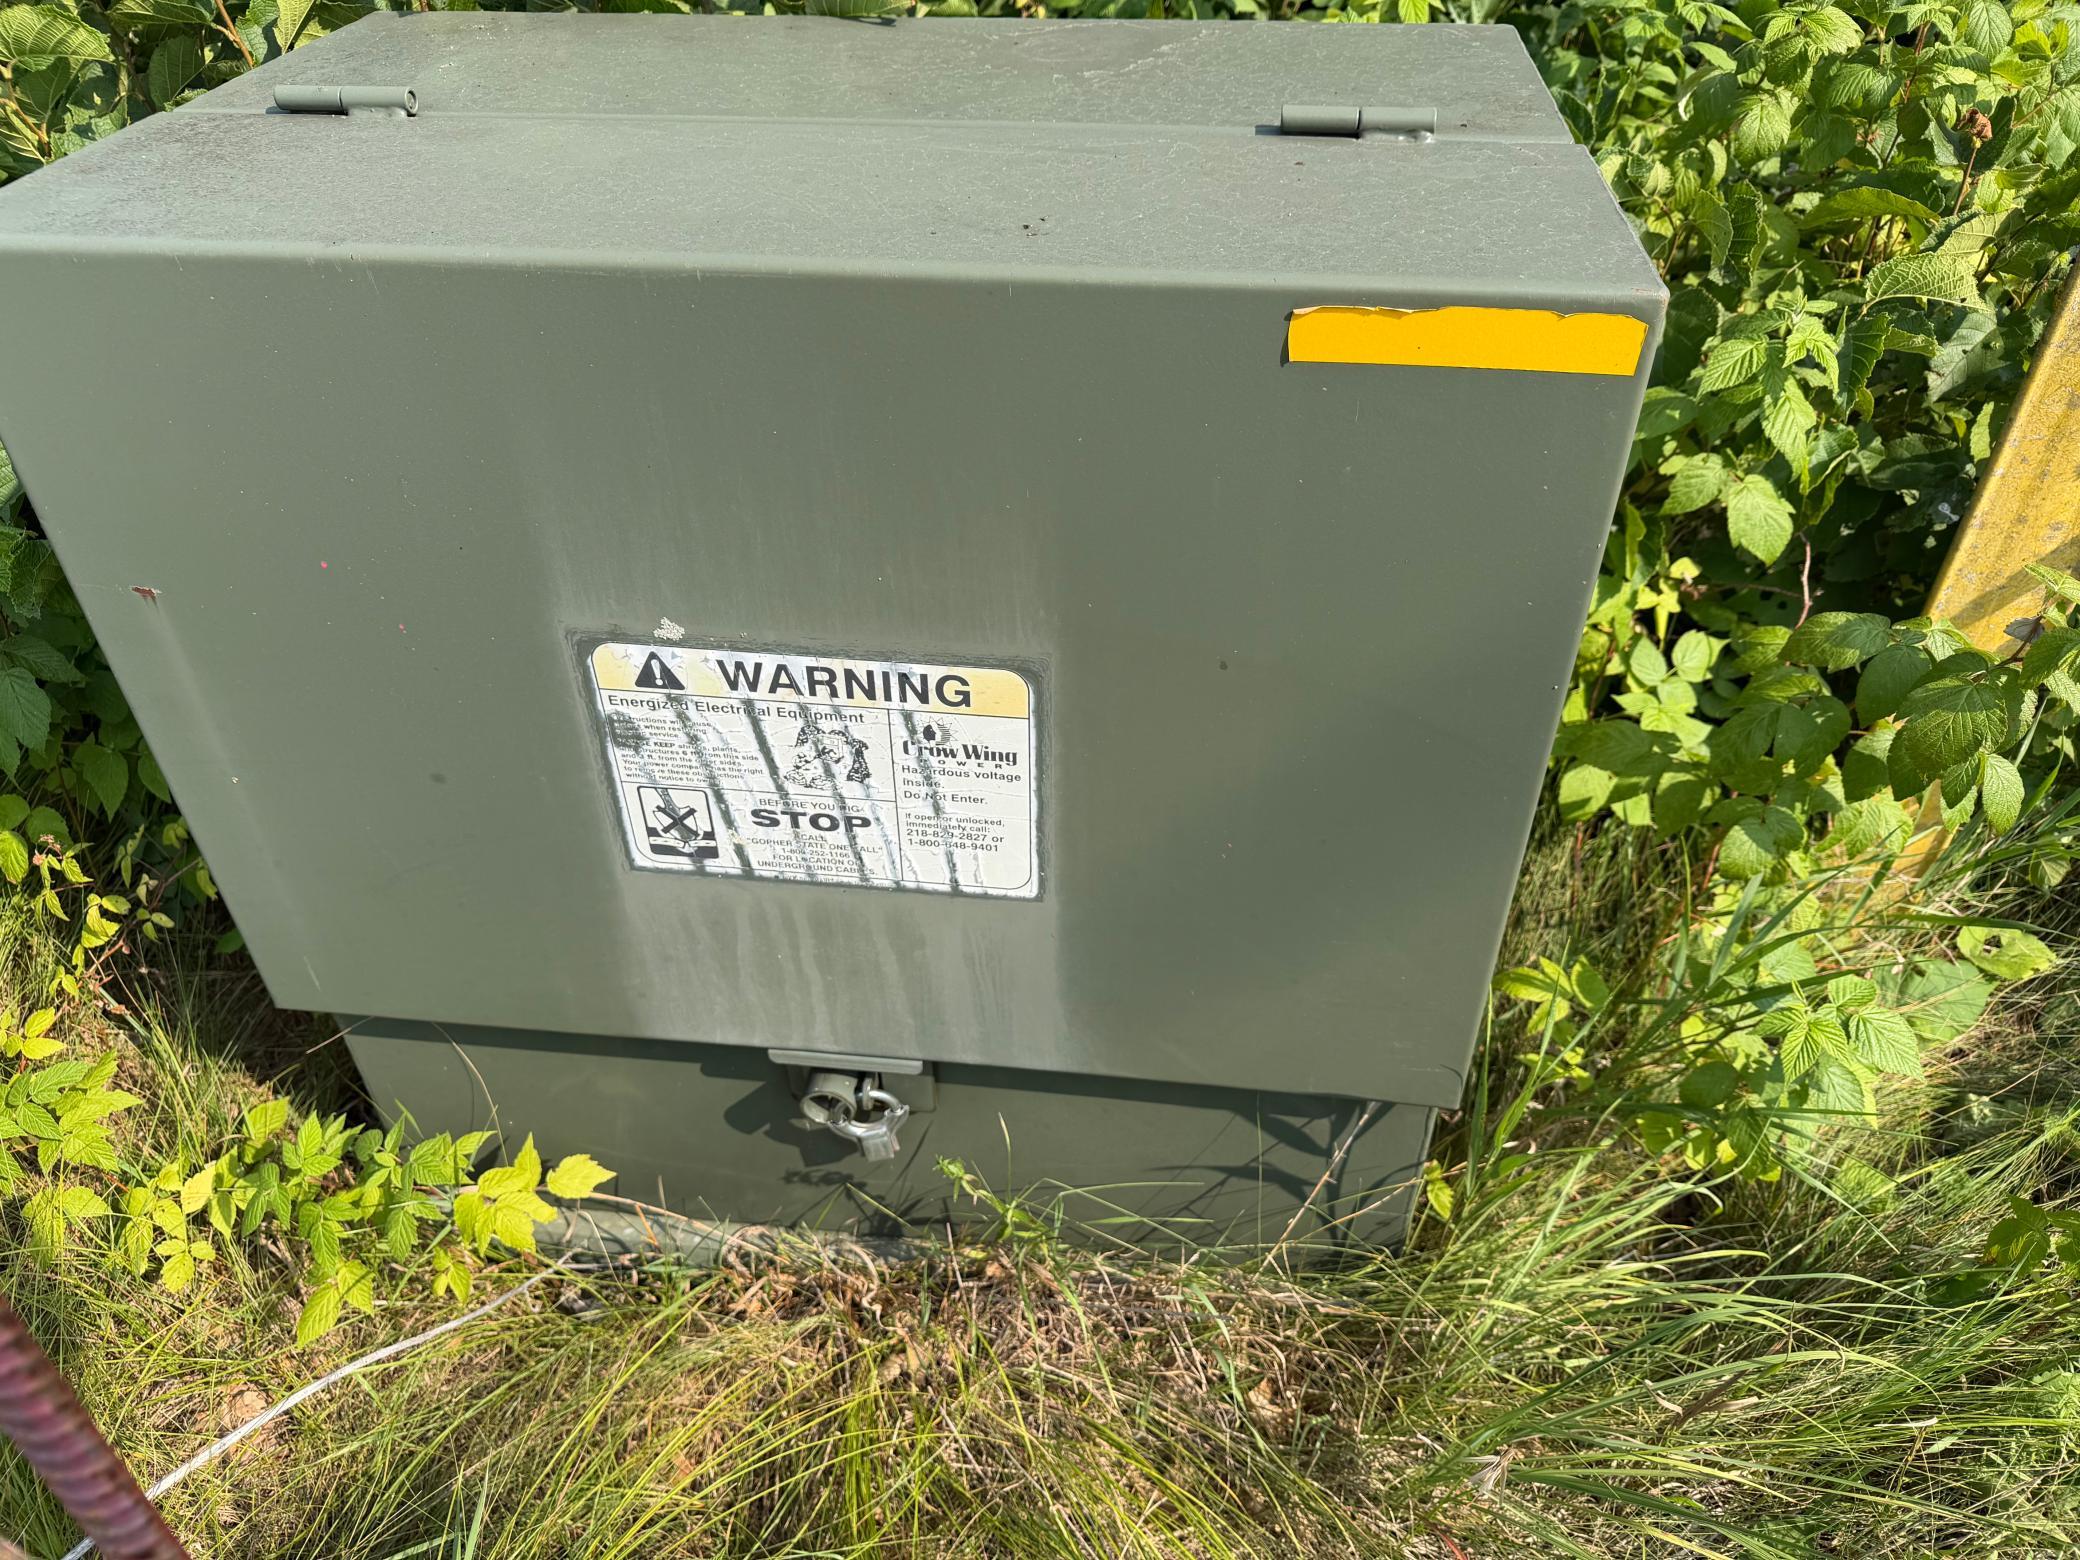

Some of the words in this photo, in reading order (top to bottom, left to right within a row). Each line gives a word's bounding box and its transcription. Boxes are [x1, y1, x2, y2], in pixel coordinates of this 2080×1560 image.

[716, 659, 971, 708] WARNING
[608, 695, 689, 711] Energized
[695, 701, 770, 717] Electrical
[777, 708, 865, 724] Equipment
[612, 713, 668, 724] tructions
[644, 723, 666, 731] when
[640, 748, 680, 756] ructures
[902, 740, 959, 759] Crow
[962, 744, 1018, 767] Wing
[644, 761, 669, 769] power
[744, 768, 764, 776] right
[695, 758, 718, 766] oer
[659, 774, 684, 782] notice
[697, 778, 723, 786] ow.
[667, 769, 690, 777] these
[692, 771, 745, 780] obuctions
[974, 772, 1022, 783] voltage
[759, 798, 808, 809] BEFORE
[810, 802, 836, 811] YOU
[904, 791, 921, 800] Do
[925, 791, 948, 802] Not
[951, 794, 989, 805] Enter.
[750, 808, 872, 833] STOP
[905, 812, 912, 820] If
[914, 814, 940, 823] open
[956, 817, 1005, 828] unlocked,
[906, 821, 967, 832] immediately
[970, 826, 991, 834] call:
[906, 828, 988, 842] 218-829-2827
[991, 836, 1005, 844] or
[828, 844, 850, 852] ONE
[852, 846, 883, 855] ALL"
[773, 854, 793, 863] FOR
[795, 855, 845, 867] LOCATION
[757, 860, 834, 873] UNDERGROUND
[835, 866, 878, 876] CABS.
